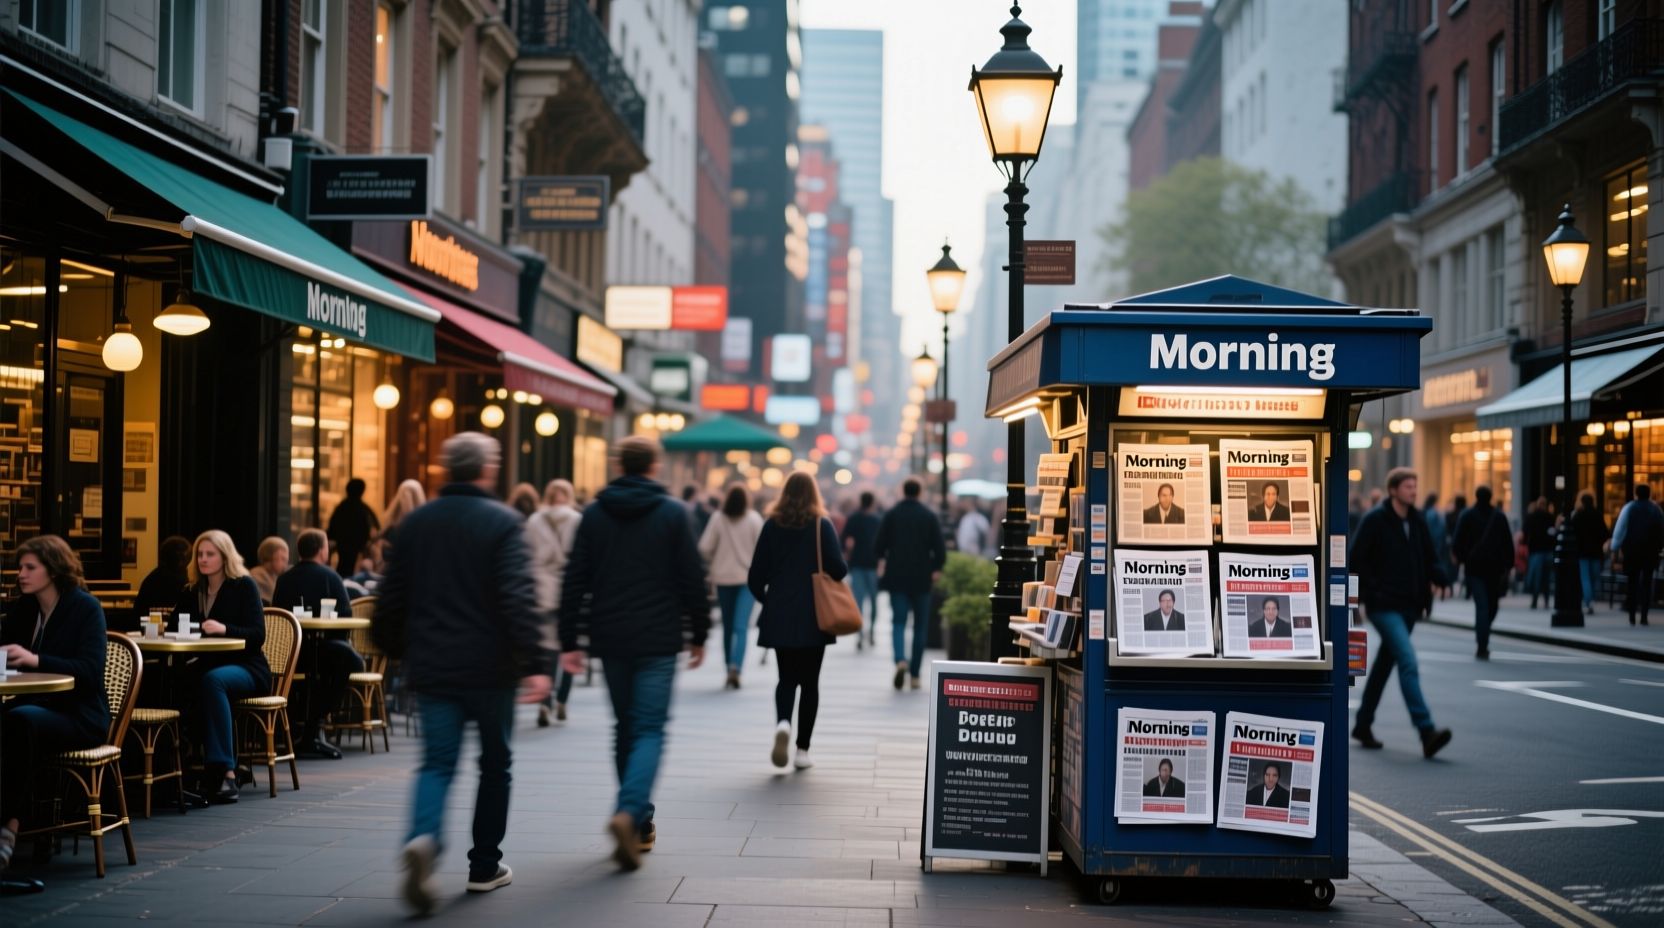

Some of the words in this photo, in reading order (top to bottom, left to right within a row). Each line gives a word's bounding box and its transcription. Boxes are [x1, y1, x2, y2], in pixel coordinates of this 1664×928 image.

[1150, 333, 1336, 380] Morning
[1125, 453, 1187, 470] Morning
[1228, 450, 1289, 466] Morning
